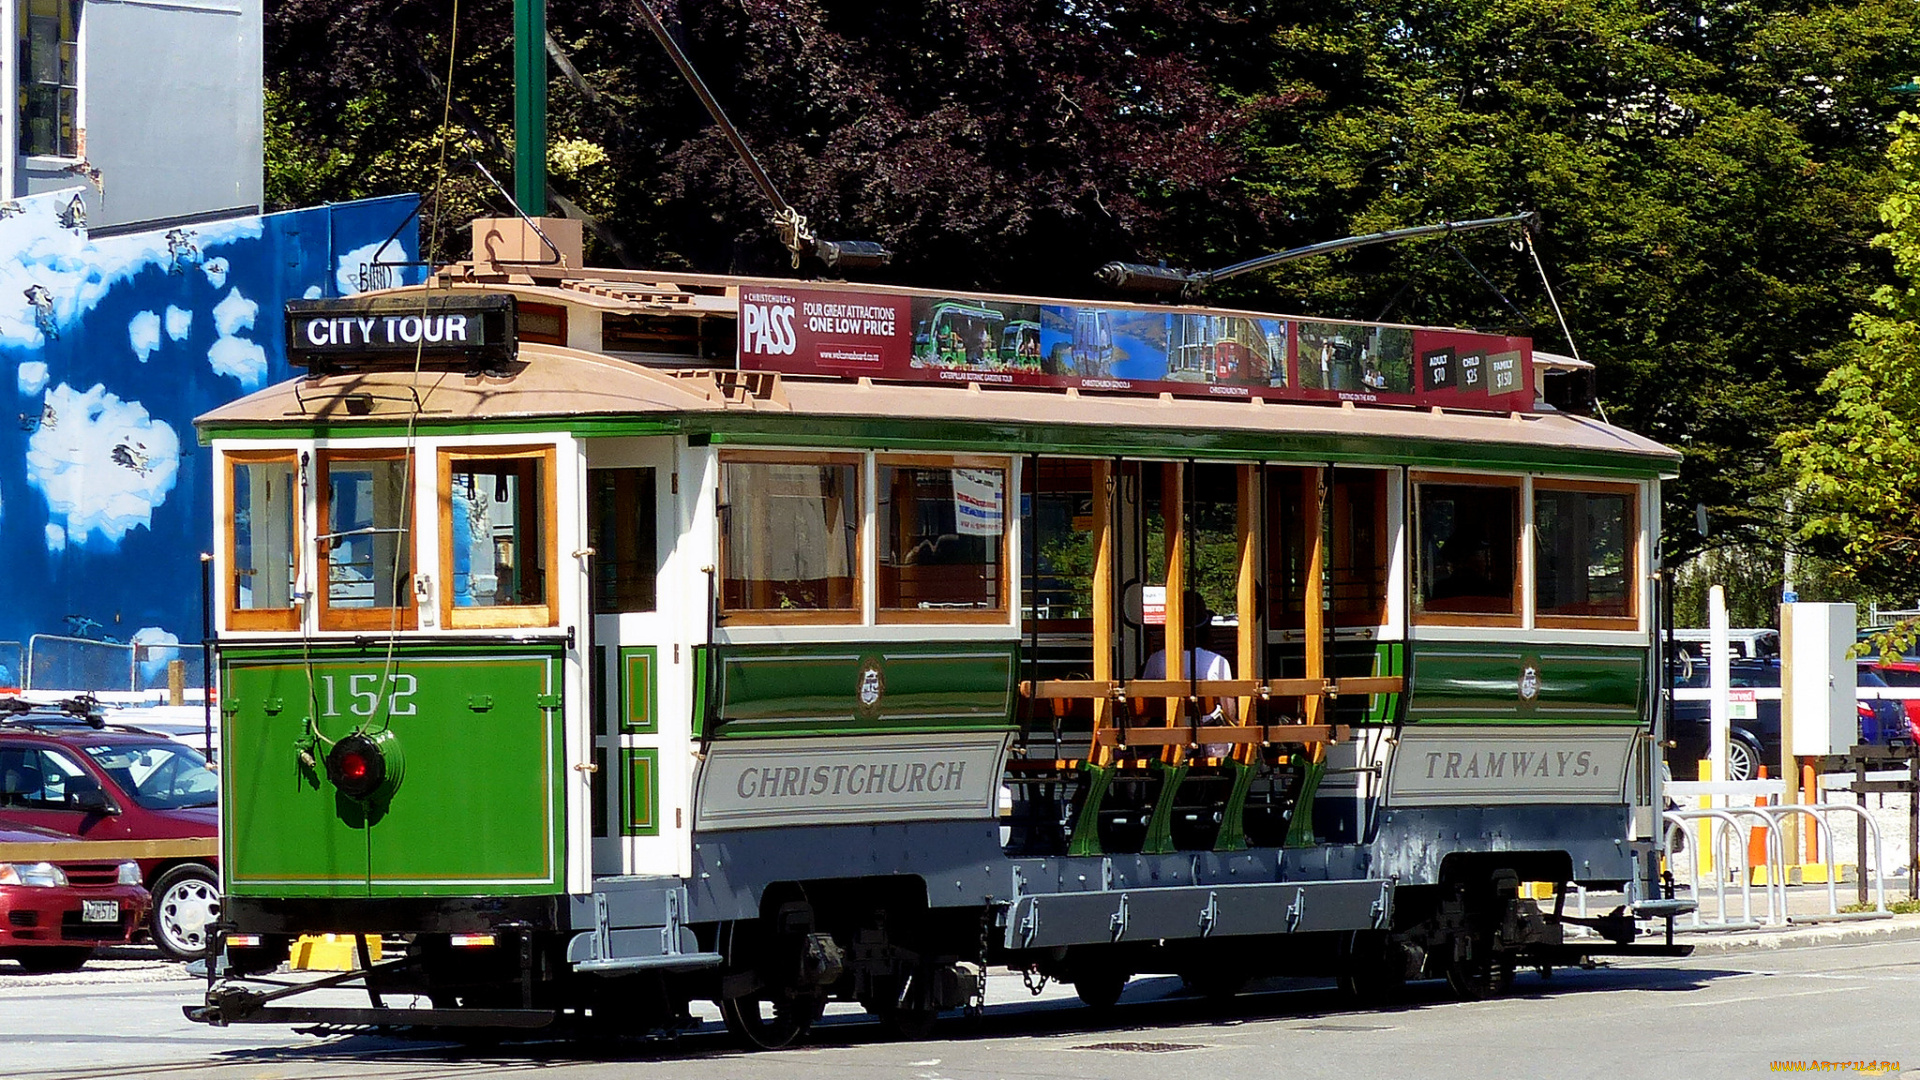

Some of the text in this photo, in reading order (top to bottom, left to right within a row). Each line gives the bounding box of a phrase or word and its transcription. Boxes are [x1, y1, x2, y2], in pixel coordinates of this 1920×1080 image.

[748, 293, 791, 304] CHRISTCHURCH
[803, 302, 895, 320] FOUR GREAT ATTRACTIONS
[307, 313, 467, 346] CITY TOUR
[744, 304, 796, 355] PASS
[809, 318, 833, 333] ONE
[836, 320, 860, 335] LOW
[863, 321, 895, 336] PRICE
[1429, 354, 1448, 367] ADULT
[1462, 355, 1480, 368] CHILD
[1493, 359, 1513, 372] FAMILY
[1433, 367, 1445, 384] $70
[1497, 371, 1512, 389] $150
[321, 674, 417, 716] 152
